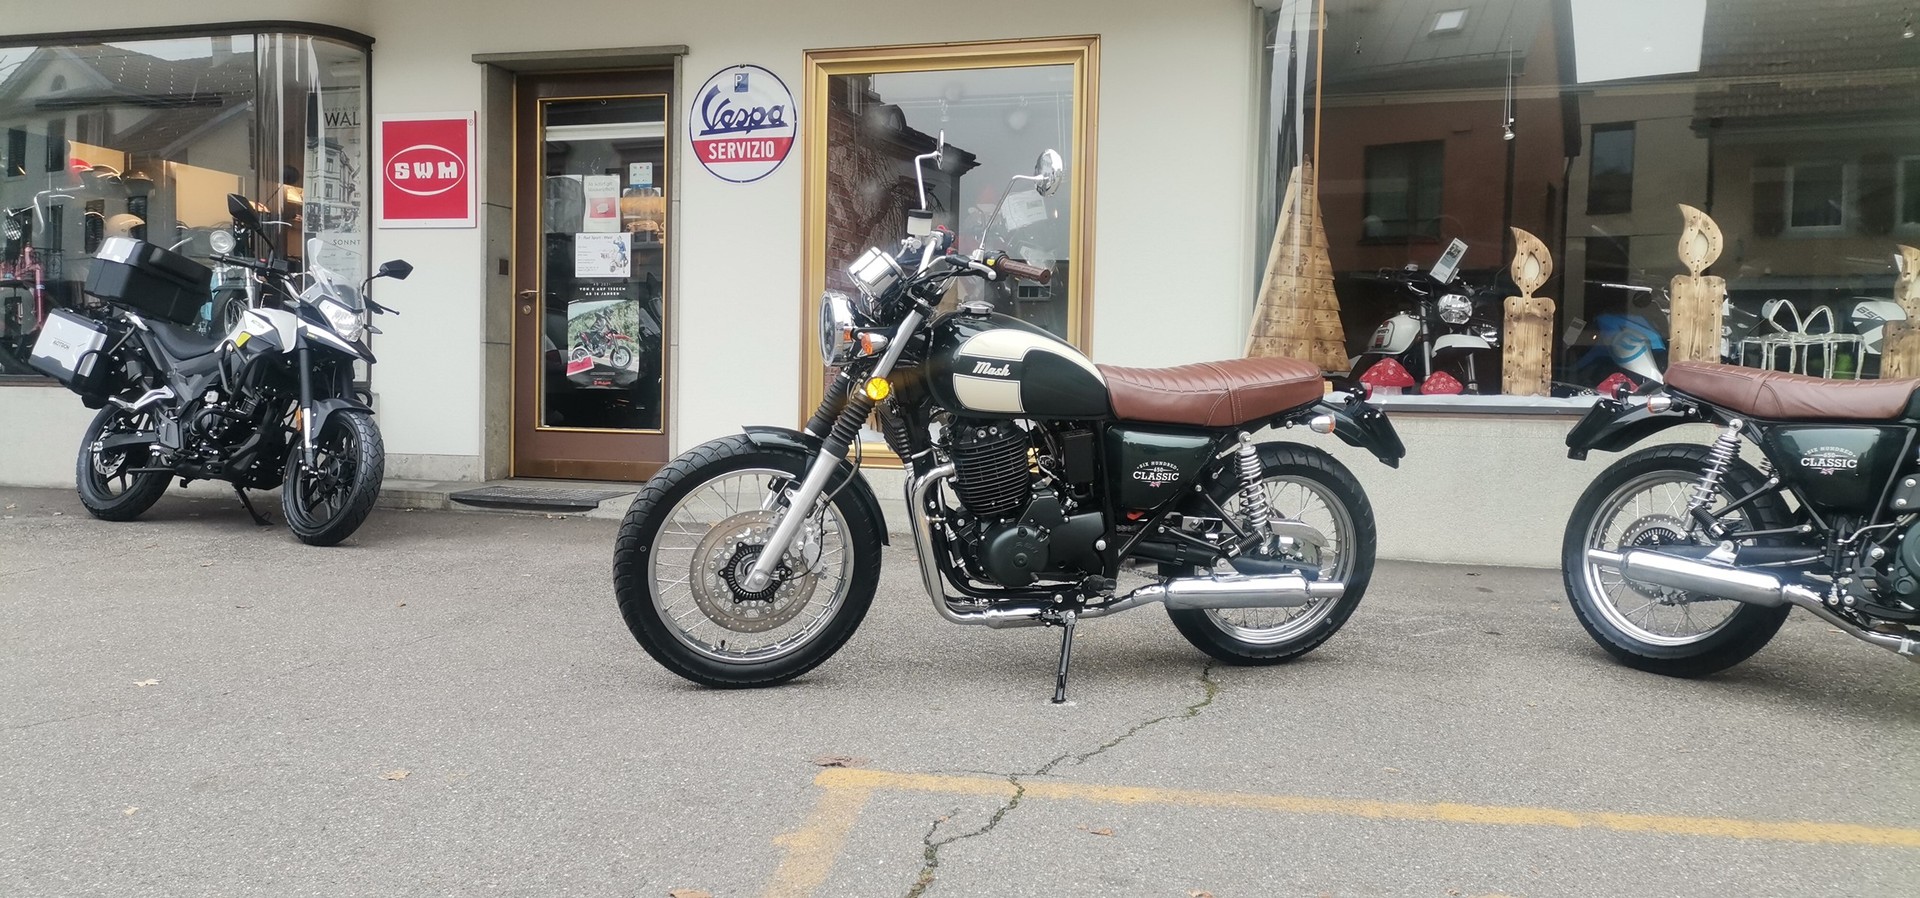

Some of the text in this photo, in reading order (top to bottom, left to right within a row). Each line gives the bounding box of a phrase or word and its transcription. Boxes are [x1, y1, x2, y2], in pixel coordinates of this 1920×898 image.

[699, 84, 789, 136] Vespa
[708, 140, 775, 160] SERVIZIO
[394, 161, 459, 180] SWM
[972, 361, 1011, 377] Mash
[1820, 446, 1854, 456] HUNDRED
[1150, 461, 1178, 470] HUNDRED
[1800, 457, 1858, 469] CLASSIC
[1132, 471, 1180, 481] CLASSIC
